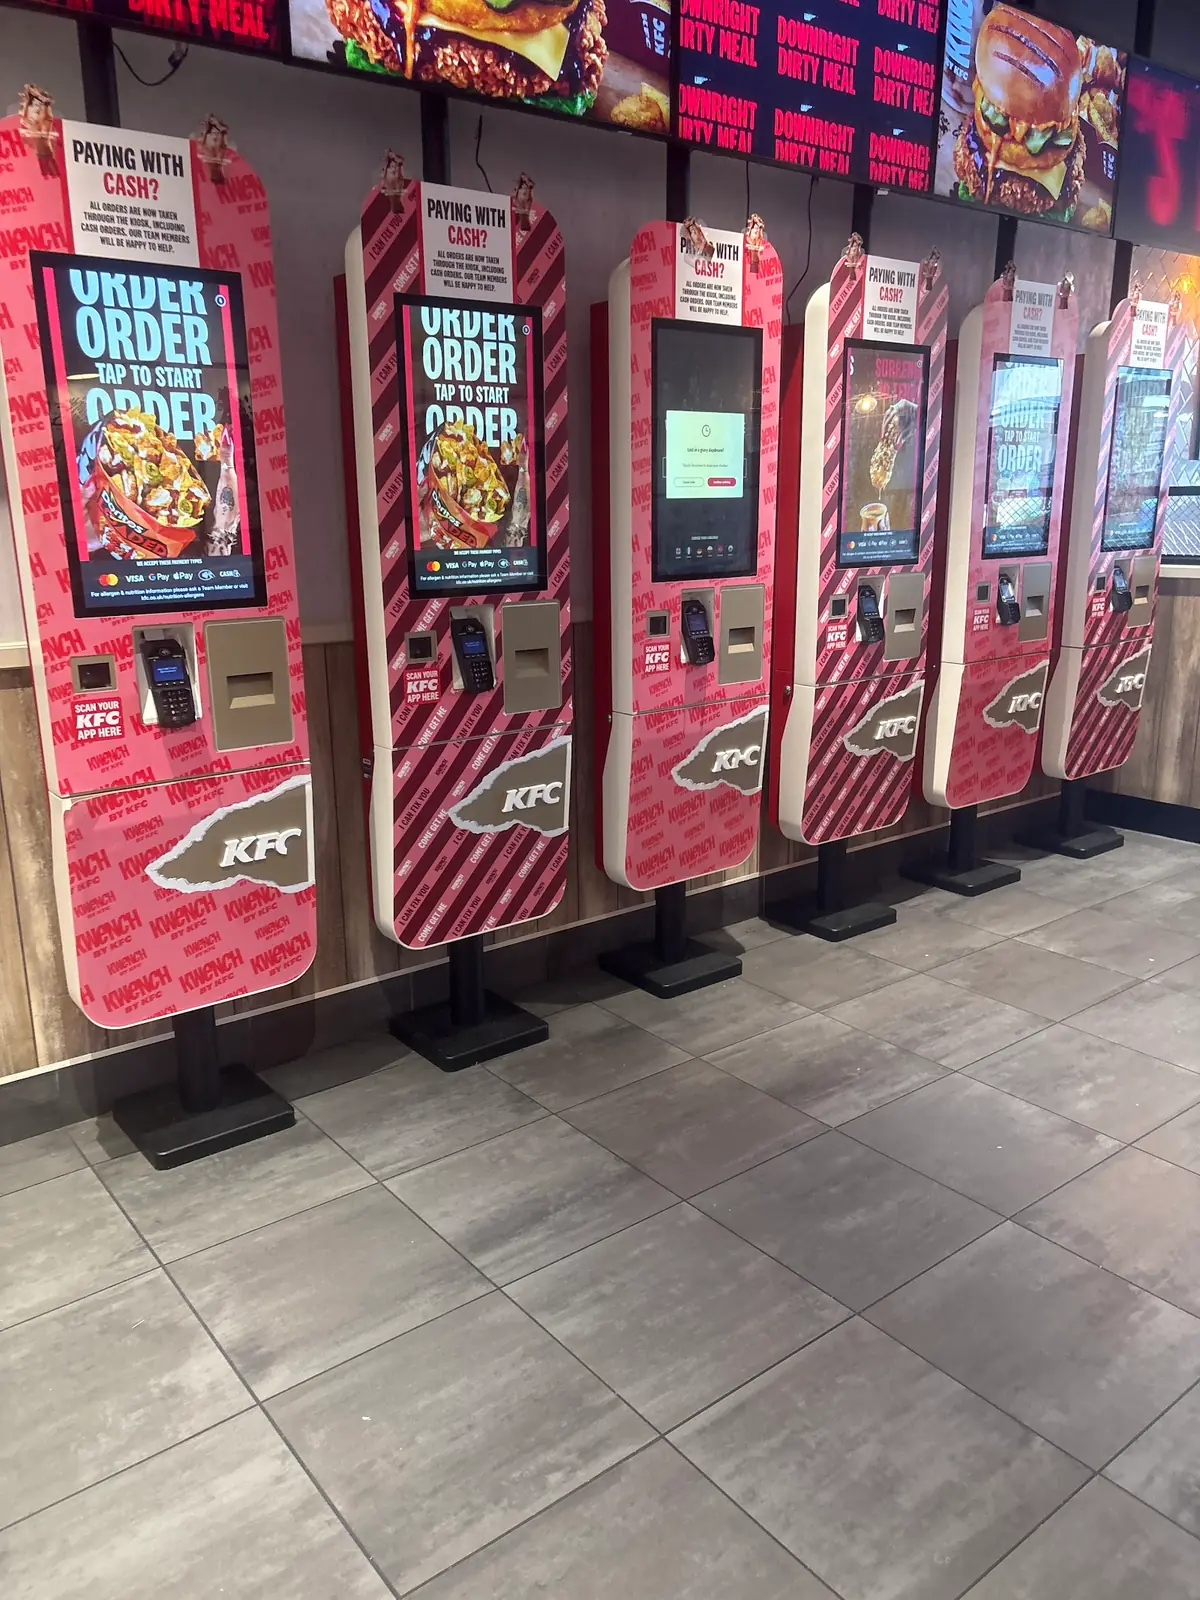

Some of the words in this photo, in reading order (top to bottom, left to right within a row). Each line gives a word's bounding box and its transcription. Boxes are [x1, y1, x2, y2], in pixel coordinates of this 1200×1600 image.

[654, 18, 665, 56] KFC
[680, 17, 715, 54] IRTY
[720, 29, 757, 67] MEAL
[777, 15, 859, 66] DOWNRIGHT
[777, 47, 820, 85] DIRTY
[823, 60, 856, 95] MEAL
[874, 76, 911, 110] DIRTY
[774, 108, 855, 153] DOWNRIGHT
[72, 139, 136, 170] PAYING
[140, 149, 184, 177] WITH
[103, 172, 159, 200] CASH?
[90, 201, 101, 211] ALL
[102, 202, 128, 214] ORDERS
[129, 206, 141, 215] ARE
[143, 208, 157, 218] NOW
[158, 210, 178, 220] TAKEN
[427, 198, 472, 224] PAYING
[475, 205, 506, 228] WITH
[83, 212, 115, 223] THROUGH
[116, 215, 128, 225] THE
[130, 217, 152, 229] KIOSK,
[152, 220, 186, 232] INCLUDING
[81, 223, 98, 232] CASH
[99, 225, 127, 237] ORDERS.
[128, 228, 142, 238] OUR
[144, 230, 160, 240] TEAM
[161, 232, 190, 244] MEMBERS
[447, 225, 488, 248] CASH?
[100, 236, 115, 246] WILL
[117, 238, 125, 247] BE
[126, 239, 147, 250] HAPPY
[148, 242, 156, 251] TO
[158, 243, 175, 254] HELP.
[716, 242, 739, 261] WITH
[433, 259, 455, 268] THROUGH
[465, 263, 480, 272] KIOSK,
[481, 265, 505, 274] INCLUDING
[437, 250, 446, 258] ALL
[446, 251, 465, 260] ORDERS
[465, 253, 474, 261] ARE
[474, 254, 485, 262] NOW
[485, 256, 500, 264] TAKEN
[430, 269, 443, 277] CASH
[444, 270, 463, 279] ORDERS.
[464, 272, 474, 280] OUR
[474, 273, 486, 282] TEAM
[486, 275, 508, 284] MEMBERS
[694, 259, 725, 279] CASH?
[868, 266, 896, 285] PAYING
[897, 271, 916, 288] WITH
[443, 279, 454, 287] WILL
[455, 280, 461, 288] BE
[461, 281, 477, 290] HAPPY
[477, 283, 483, 291] TO
[484, 284, 496, 292] HELP.
[879, 286, 903, 303] CASH?
[76, 305, 213, 366] ORDER
[422, 337, 517, 384] ORDER
[95, 362, 127, 385] TAP
[130, 364, 152, 386] TO
[155, 365, 202, 389] START
[434, 383, 455, 401] TAP
[458, 384, 473, 402] TO
[475, 386, 509, 404] START
[125, 574, 145, 583] VISA
[157, 573, 170, 582] Pay
[179, 571, 194, 581] Pay
[973, 614, 990, 624] KFC
[827, 631, 846, 642] KFC
[645, 645, 658, 653] SCAN
[645, 651, 670, 664] KFC
[406, 672, 422, 680] SCAN
[422, 670, 438, 678] YOUR
[645, 664, 655, 672] APP
[406, 679, 438, 693] KFC
[74, 703, 97, 713] SCAN
[97, 700, 119, 711] YOUR
[407, 693, 421, 703] APP
[421, 692, 440, 701] HERE
[1008, 692, 1042, 713] KFC
[76, 710, 121, 729] KFC
[873, 715, 917, 740] KFC
[78, 729, 97, 740] APP
[98, 726, 122, 738] HERE
[711, 745, 761, 773] KFC
[401, 811, 414, 826] CAN
[410, 801, 421, 813] FIX
[417, 787, 430, 801] YOU
[501, 781, 563, 813] KFC
[418, 830, 433, 848] COME
[430, 818, 441, 831] GET
[437, 808, 448, 820] ME
[219, 828, 302, 868] KFC
[517, 861, 532, 878] COME
[528, 850, 539, 862] GET
[536, 840, 546, 852] ME
[170, 930, 184, 941] BY
[185, 917, 207, 932] KFC
[200, 983, 214, 995] BY
[214, 972, 234, 987] KFC
